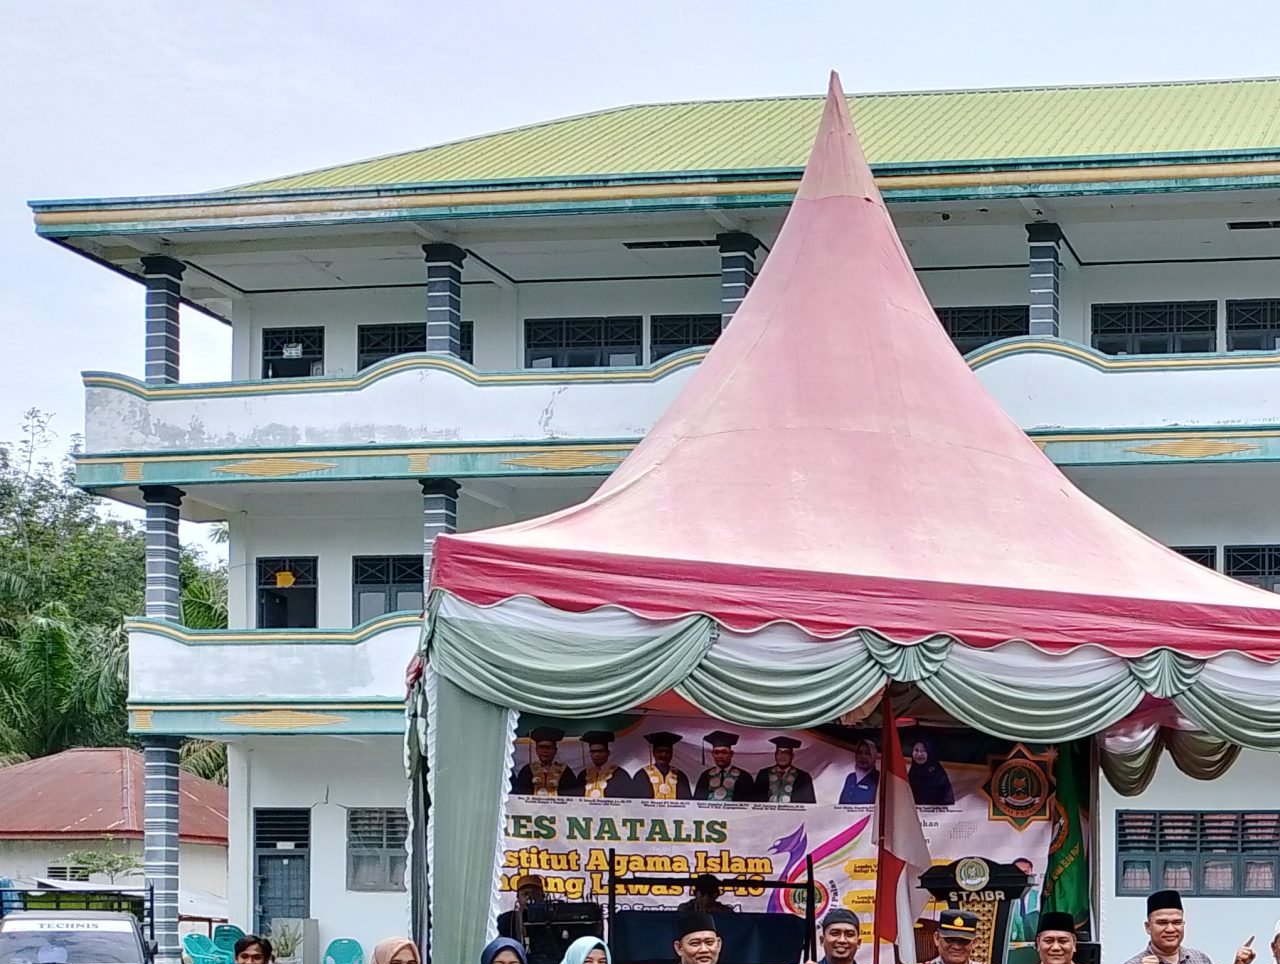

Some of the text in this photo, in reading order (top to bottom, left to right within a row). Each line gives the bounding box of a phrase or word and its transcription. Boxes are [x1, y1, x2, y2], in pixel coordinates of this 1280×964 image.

[566, 816, 728, 844] NATALIS
[585, 848, 690, 875] Agama
[695, 850, 773, 875] Islam
